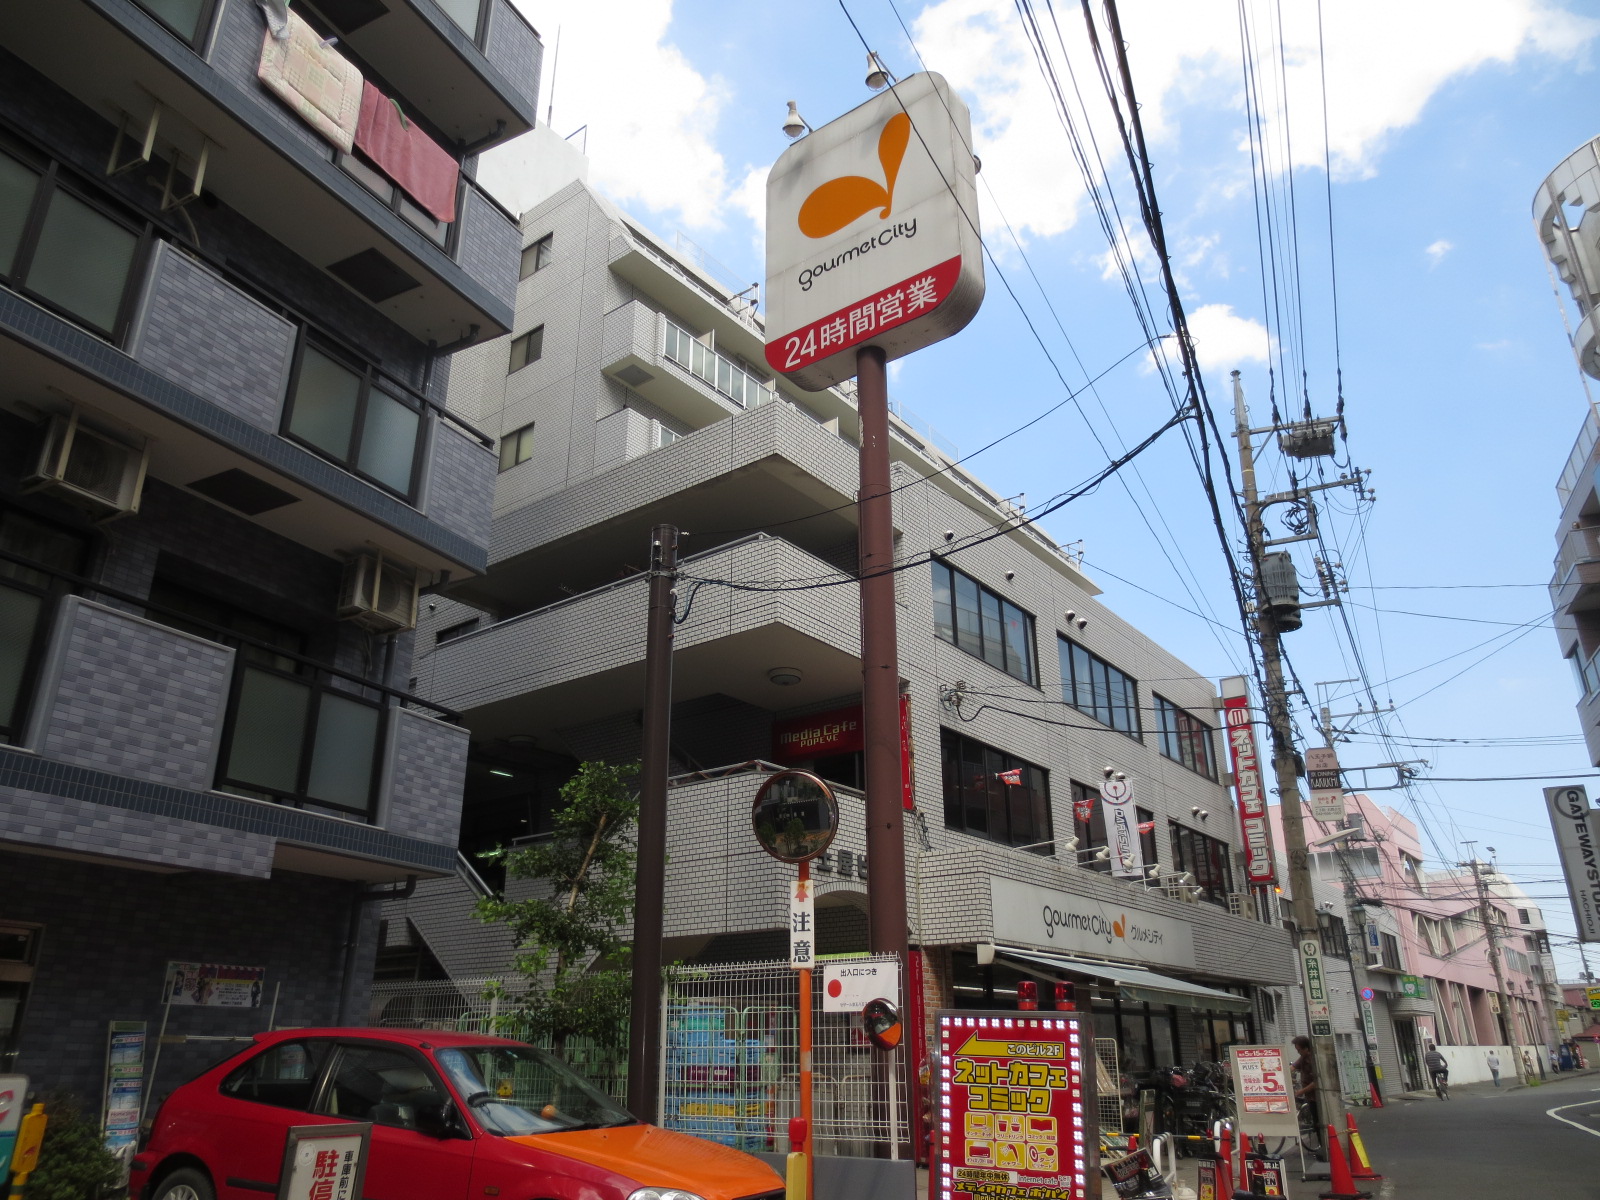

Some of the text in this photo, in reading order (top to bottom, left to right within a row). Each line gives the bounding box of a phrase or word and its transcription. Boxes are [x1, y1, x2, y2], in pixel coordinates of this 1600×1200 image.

[784, 275, 938, 369] 24時間営業
[800, 733, 839, 748] POPEYE
[1231, 729, 1262, 813] ネットカフェ
[1245, 818, 1270, 876] コミック
[1579, 889, 1596, 934] HACHIOJI
[792, 911, 811, 963] 注意
[1130, 926, 1163, 945] グルメシティ
[840, 967, 878, 978] 出入口につき
[1307, 958, 1322, 999] 糸井歯科
[1007, 1043, 1061, 1057] このビル2F
[954, 1059, 1068, 1090] ネットカフェ
[968, 1086, 1052, 1114] コミック
[954, 1181, 1027, 1197] メディアカフェ
[956, 1168, 1010, 1183] 24時間年中無休
